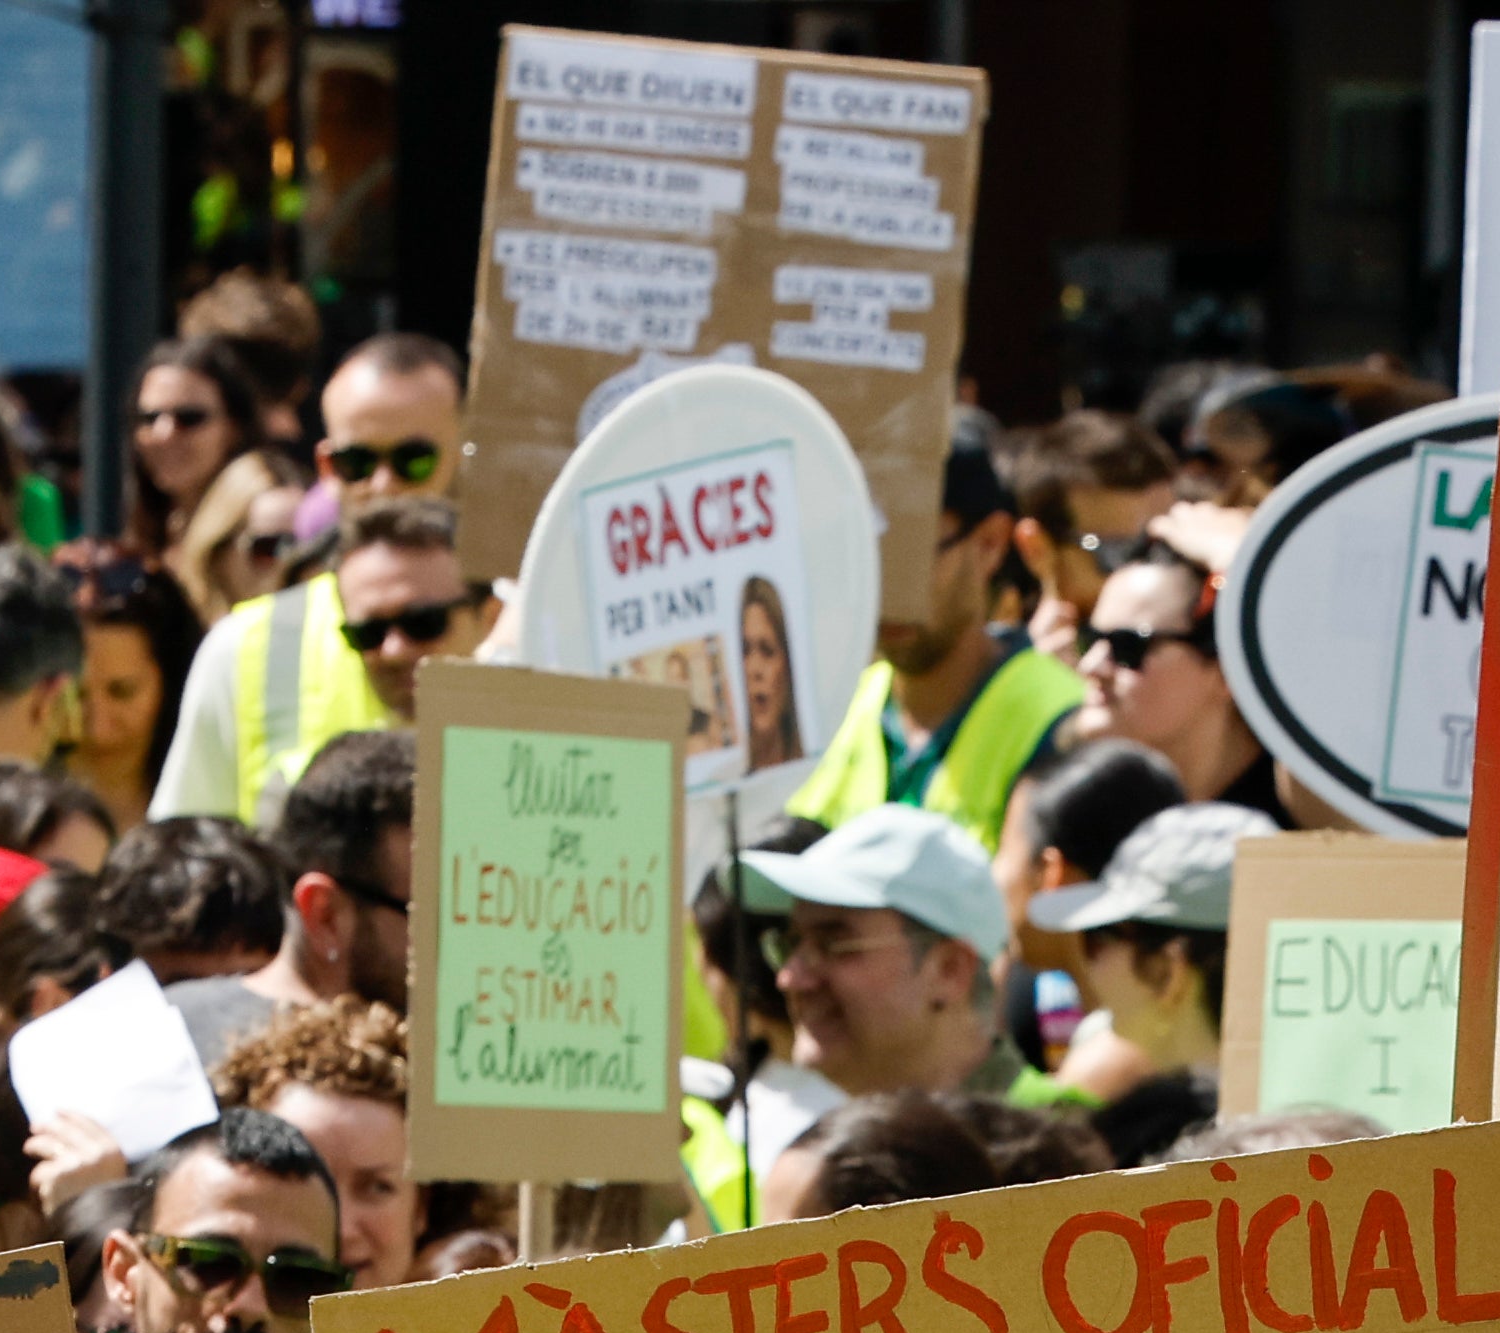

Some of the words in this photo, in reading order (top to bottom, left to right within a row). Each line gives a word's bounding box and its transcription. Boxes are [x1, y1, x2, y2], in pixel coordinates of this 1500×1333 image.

[606, 470, 775, 576] GRÀCIES
[605, 602, 644, 639] PER
[653, 578, 718, 628] TANT
[475, 965, 622, 1027] ESTIMAR
[1271, 935, 1463, 1019] EDUCA
